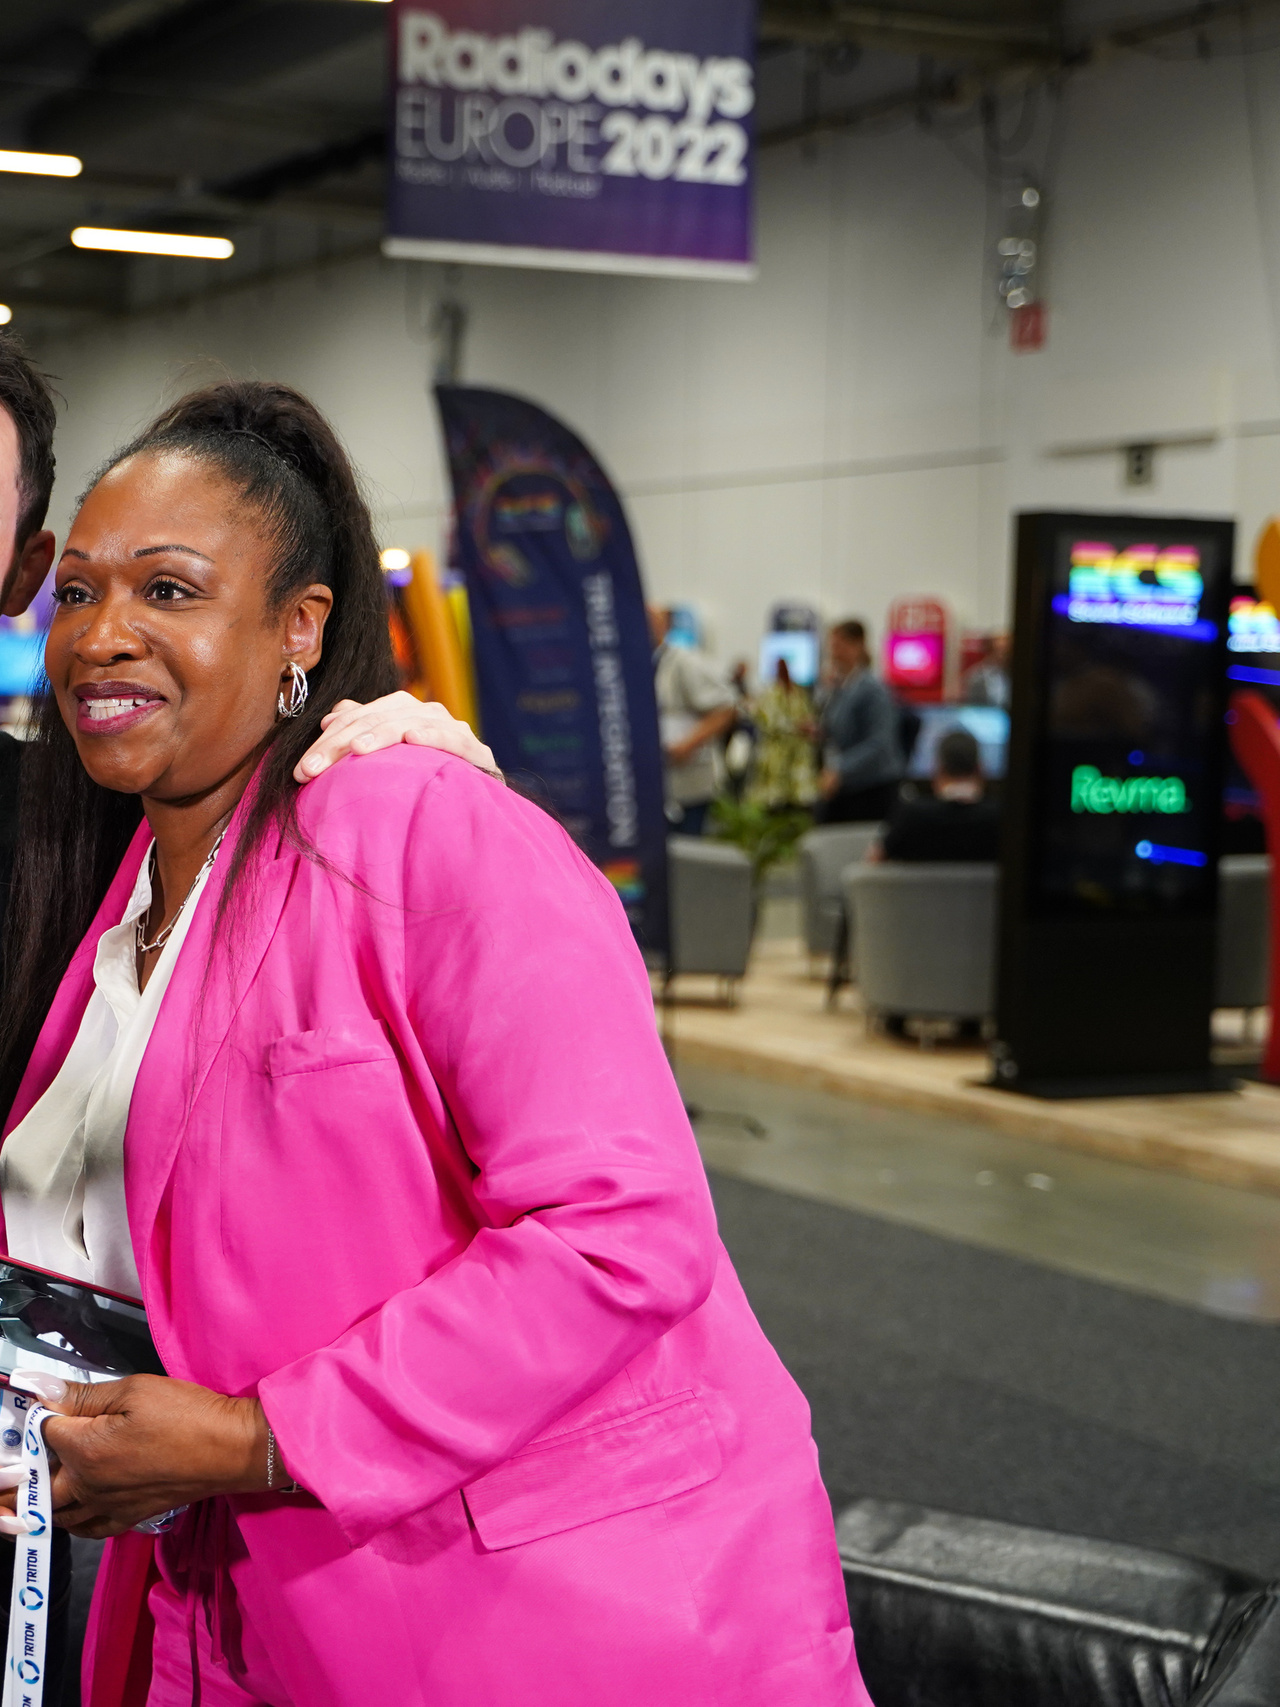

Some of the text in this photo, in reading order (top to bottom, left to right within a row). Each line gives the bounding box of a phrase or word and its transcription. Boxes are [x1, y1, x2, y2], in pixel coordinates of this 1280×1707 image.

[398, 11, 754, 123] Radiodays
[397, 87, 603, 174] EUROPE
[600, 111, 748, 186] 2022
[27, 1468, 38, 1507] TRITON
[26, 1548, 38, 1583] TRITON
[24, 1621, 35, 1656] TRITON
